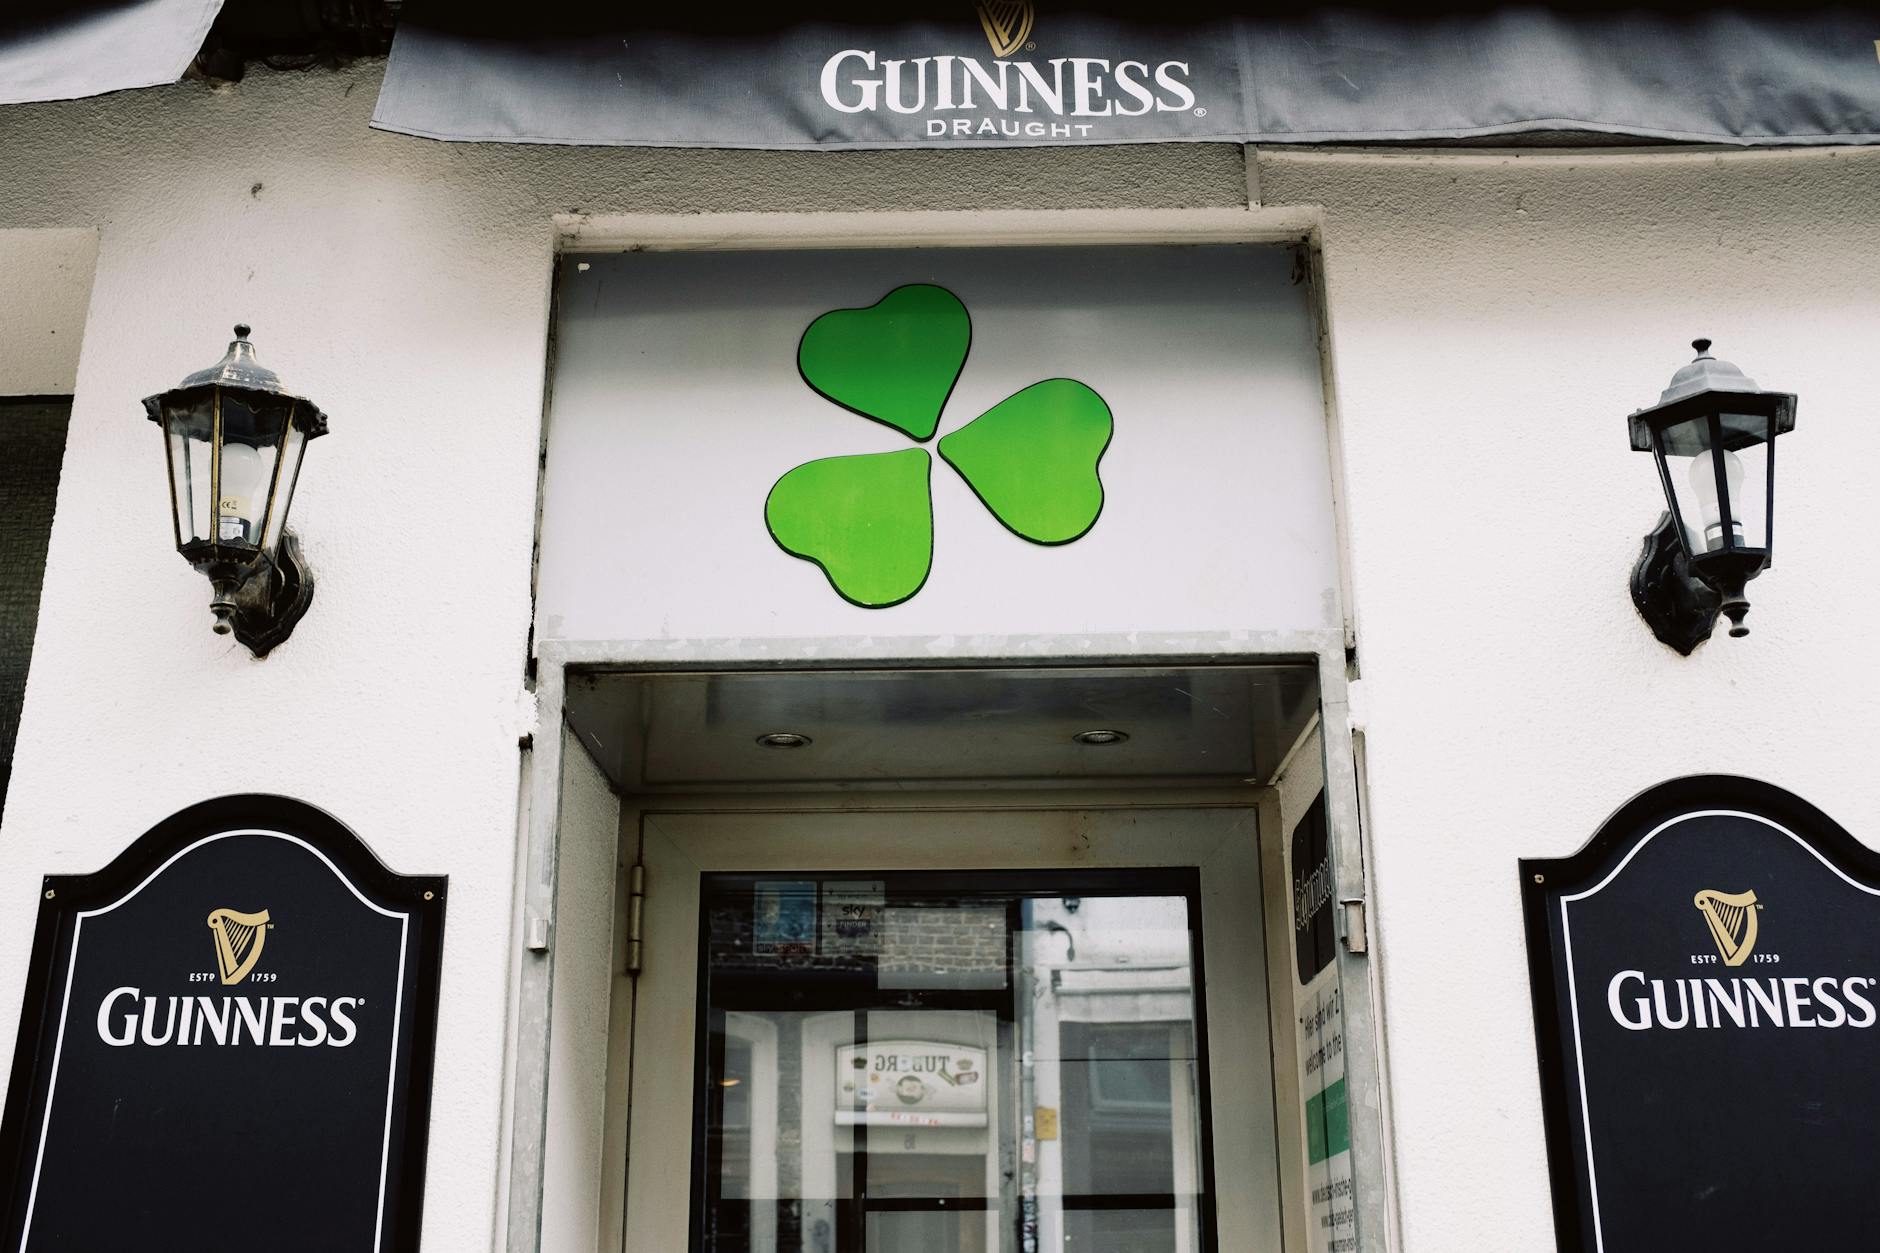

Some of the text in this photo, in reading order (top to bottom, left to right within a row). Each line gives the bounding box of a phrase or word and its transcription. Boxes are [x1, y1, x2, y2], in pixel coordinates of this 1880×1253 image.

[820, 49, 1197, 117] GUINNESS
[926, 118, 1093, 138] DRAUGHT
[251, 973, 278, 983] 1759
[1754, 953, 1780, 964] 1759
[97, 986, 357, 1047] GUINNESS
[1607, 970, 1877, 1031] GUINNESS
